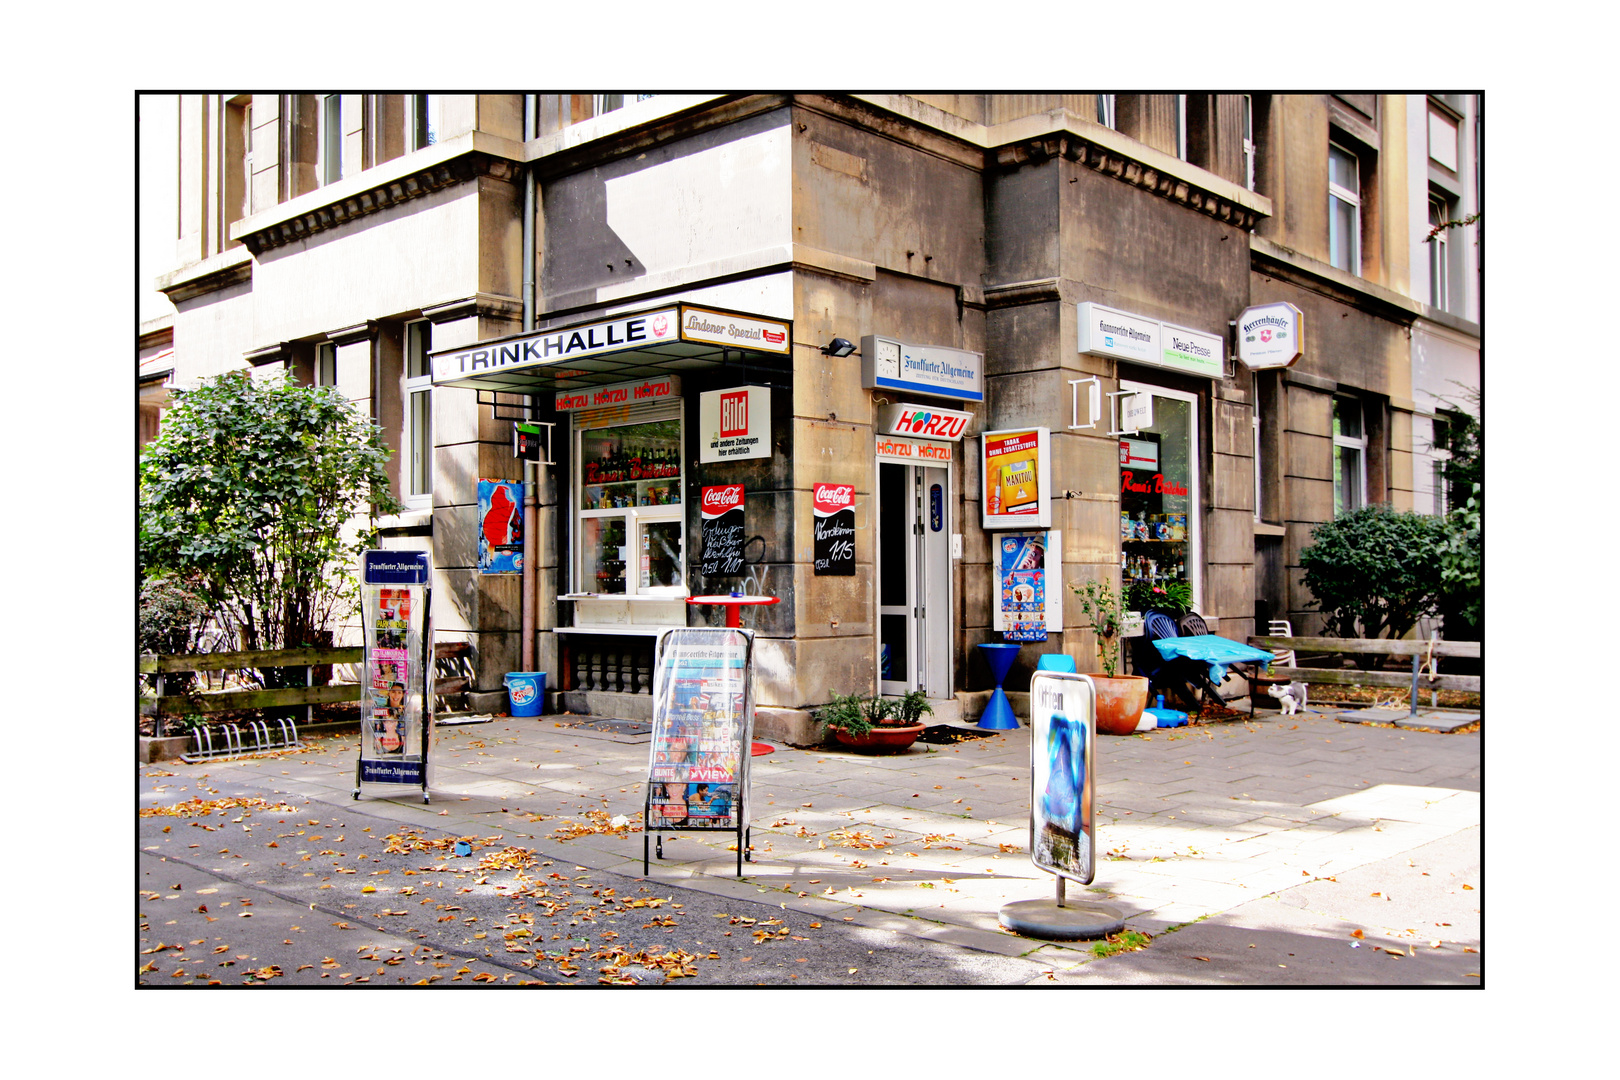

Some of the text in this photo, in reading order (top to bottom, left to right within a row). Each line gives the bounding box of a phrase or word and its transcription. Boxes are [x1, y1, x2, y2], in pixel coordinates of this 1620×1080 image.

[685, 315, 726, 335] Lindener
[728, 323, 761, 341] Spezial
[455, 319, 646, 372] TRINKHALLE
[1173, 337, 1211, 357] Neue Presse
[904, 355, 974, 380] Frankfurter Allgemeine
[723, 396, 746, 431] Bild
[710, 437, 758, 449] und andere Zeitungen
[989, 440, 1036, 457] OHNE ZUSATZSTOFFE
[1004, 438, 1020, 447] TABAK
[728, 447, 750, 456] erhältlich
[1005, 471, 1032, 487] MANITOU
[704, 487, 741, 506] Coca-Cola
[816, 485, 852, 505] Coca-Cola
[368, 562, 425, 572] Frankfurter Allgemeine
[365, 766, 420, 777] Frankfurter Allgemeine
[654, 768, 674, 777] BUNTE
